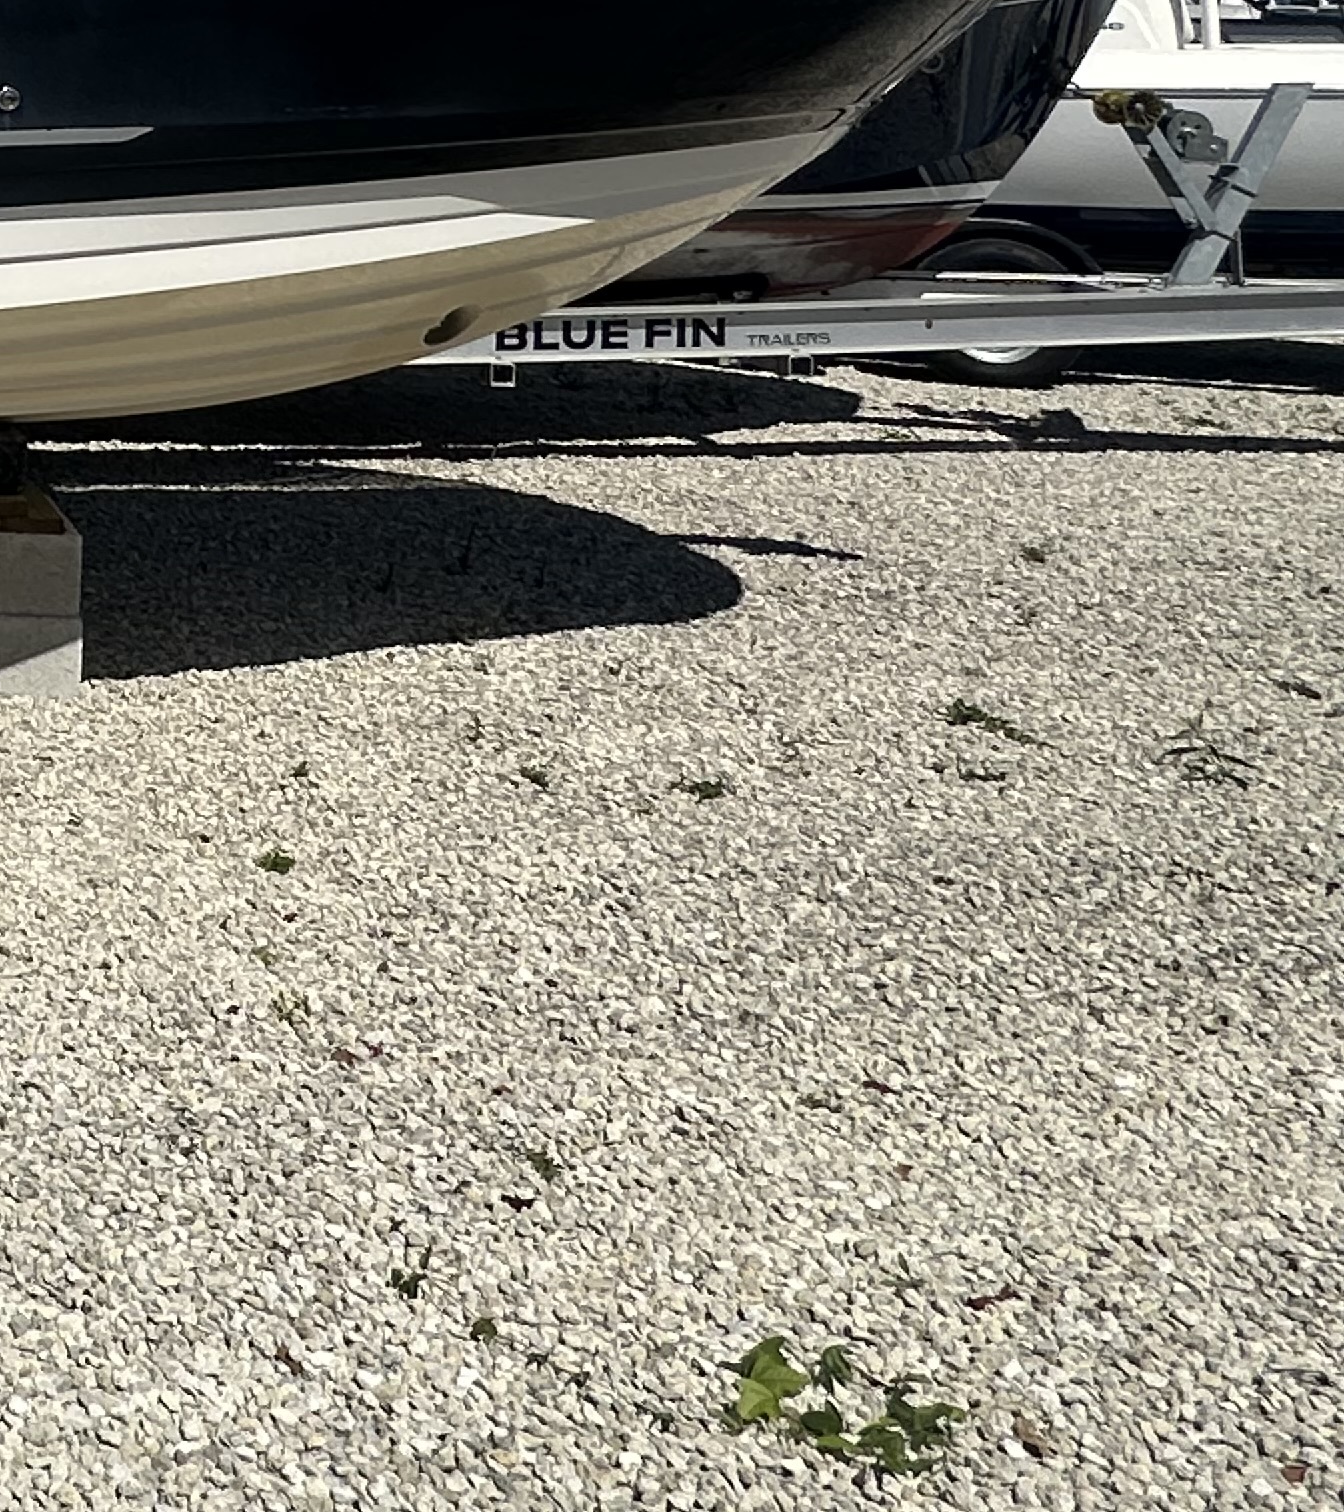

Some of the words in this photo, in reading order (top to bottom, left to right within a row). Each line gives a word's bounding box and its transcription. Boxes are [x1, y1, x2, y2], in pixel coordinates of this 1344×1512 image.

[494, 318, 629, 352] BLUE
[644, 317, 727, 348] FIN
[745, 332, 832, 347] TRAILERS
